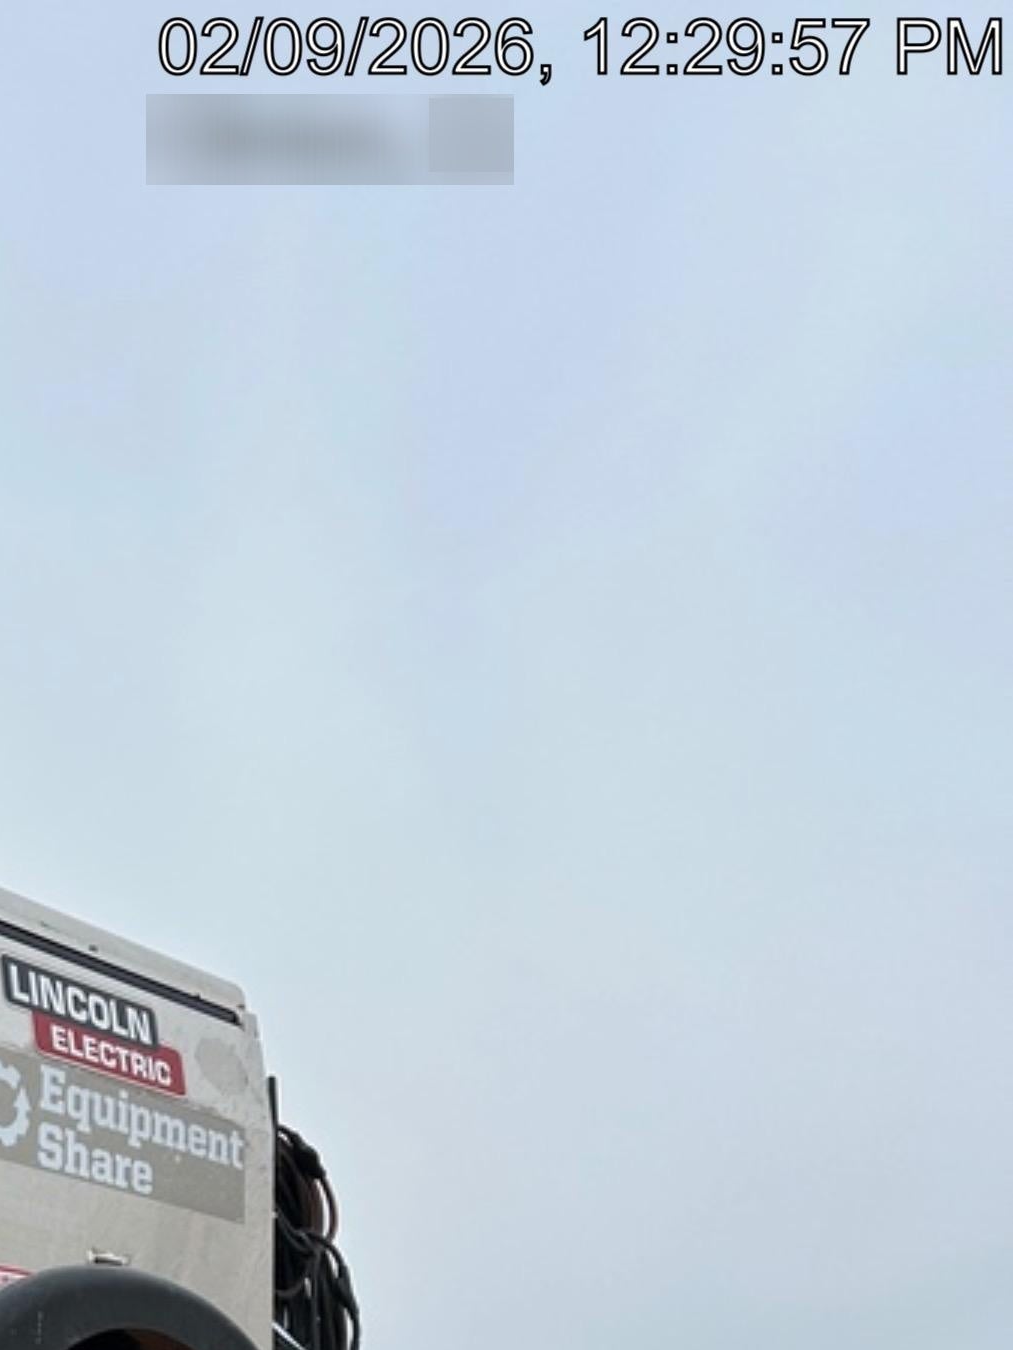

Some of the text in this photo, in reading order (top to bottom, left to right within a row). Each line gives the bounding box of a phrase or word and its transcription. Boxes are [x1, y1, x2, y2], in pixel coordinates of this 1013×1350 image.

[9, 962, 153, 1046] LINCOLN
[50, 1024, 172, 1087] ELECTRIC
[39, 1063, 244, 1170] Equipment
[38, 1120, 154, 1195] Share
